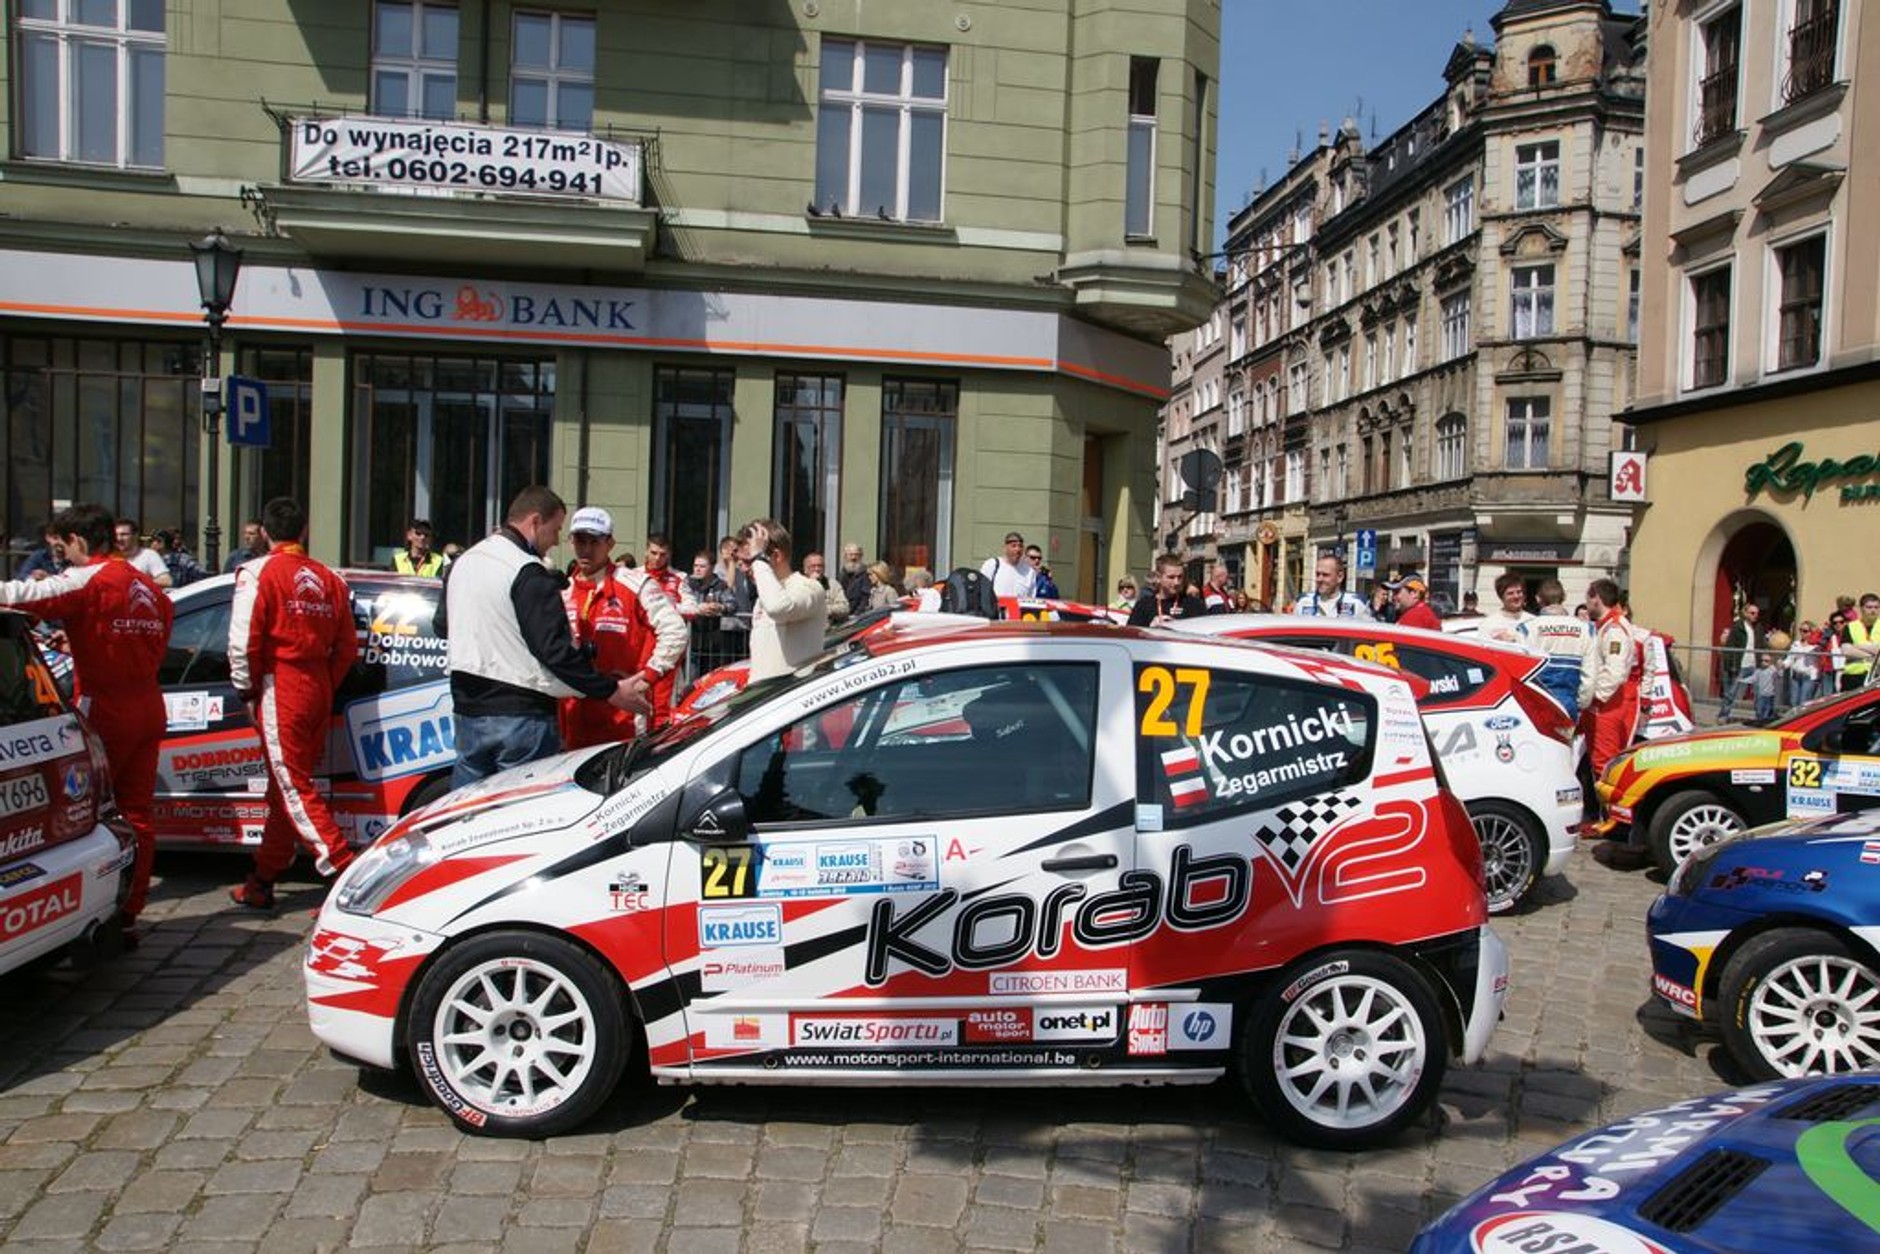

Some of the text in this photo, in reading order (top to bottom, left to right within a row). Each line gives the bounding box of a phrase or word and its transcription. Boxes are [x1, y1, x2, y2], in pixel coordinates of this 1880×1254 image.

[304, 123, 338, 146] Do
[348, 129, 492, 158] wynajęcia
[329, 155, 380, 178] tel.
[363, 286, 636, 330] ING BANK
[237, 385, 261, 437] P
[1361, 551, 1372, 566] P
[801, 658, 917, 709] www.korab2.pl
[1138, 666, 1211, 737] 27
[0, 733, 53, 761] vera
[1198, 702, 1356, 766] Kornicki
[1214, 751, 1348, 798] Zegarmistrz
[1790, 760, 1821, 788] 32
[594, 788, 643, 821] Kornicki
[602, 788, 666, 833] Zegarmistrz
[1790, 795, 1832, 809] KRAUSE
[773, 857, 804, 866] KRAUSE
[820, 853, 868, 868] KRAUSE
[946, 837, 966, 861] A
[704, 848, 751, 897] 27
[864, 843, 1253, 986] Korab
[705, 920, 776, 941] KRAUSE
[725, 963, 783, 976] Platinum
[1073, 973, 1123, 990] BANK
[1655, 973, 1697, 1005] WRC
[967, 1011, 1017, 1023] auto
[978, 1021, 1026, 1031] motor
[1039, 1011, 1110, 1031] onet.pl
[1128, 1003, 1167, 1030] Auto
[995, 1028, 1031, 1039] sport
[785, 1050, 1076, 1067] www.motorsport-international.be
